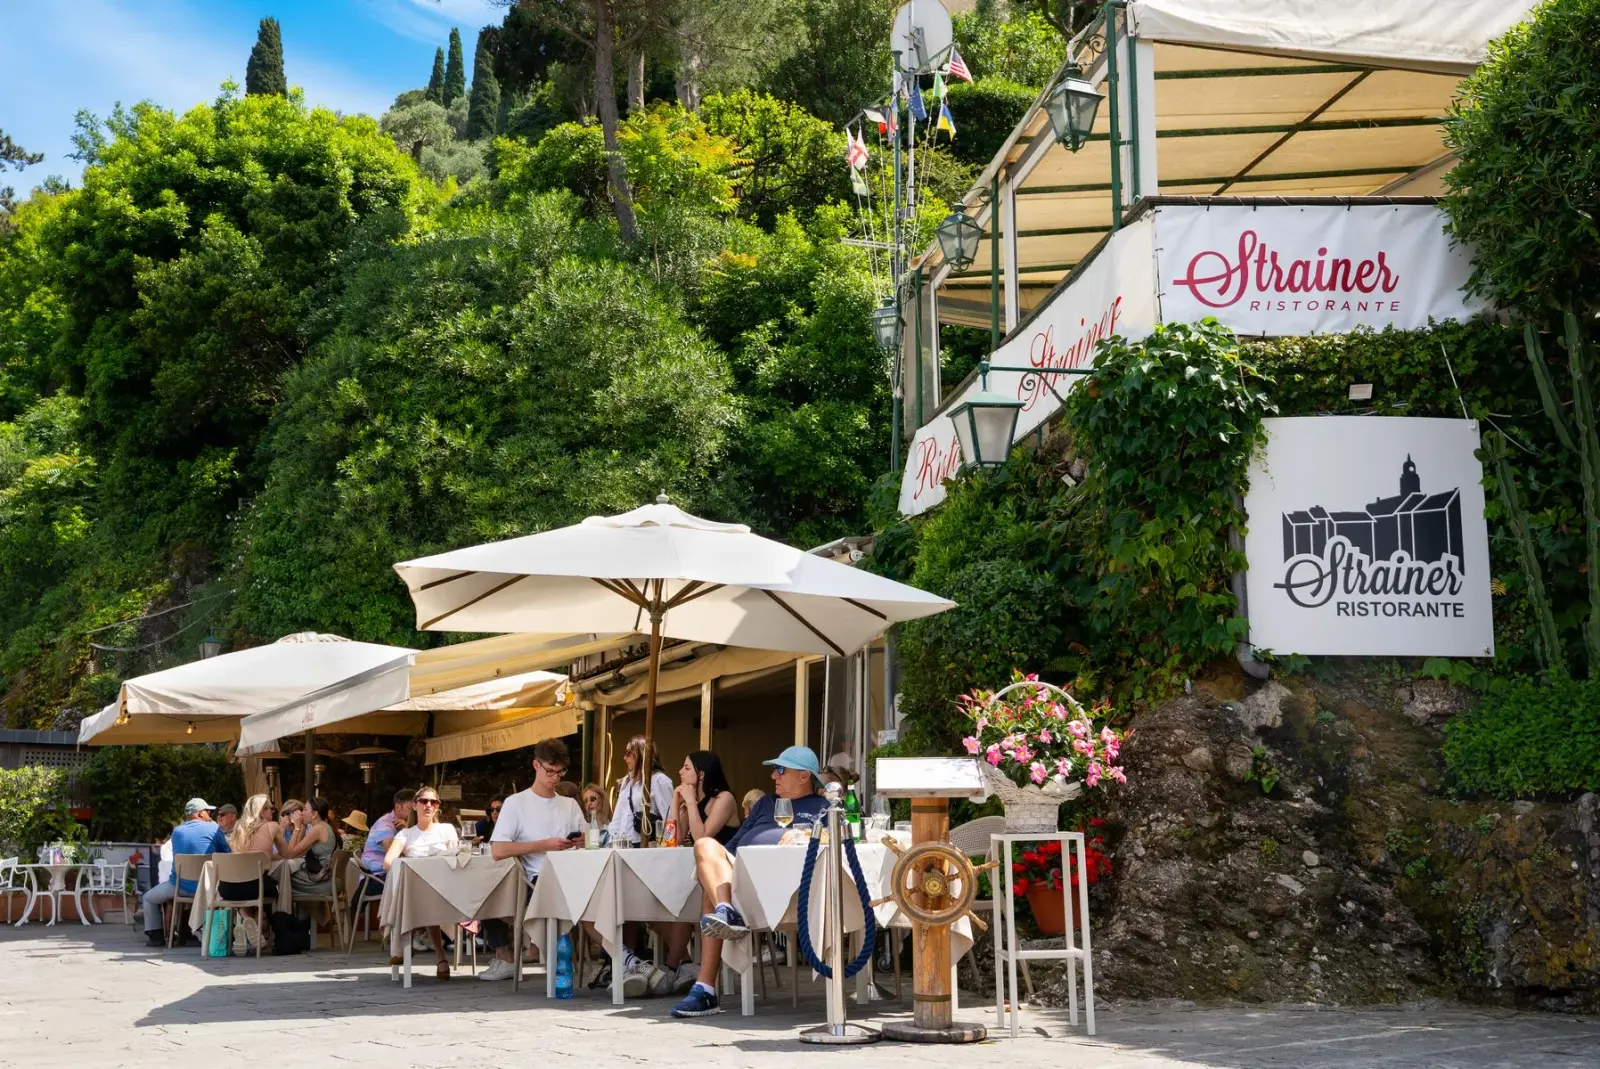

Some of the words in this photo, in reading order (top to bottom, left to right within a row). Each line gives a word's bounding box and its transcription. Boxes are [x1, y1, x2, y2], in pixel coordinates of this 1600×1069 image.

[1172, 229, 1400, 308] Strainer
[1249, 300, 1400, 312] RISTORANTE
[1272, 540, 1463, 609] Strainer
[1336, 601, 1465, 618] RISTORANTE
